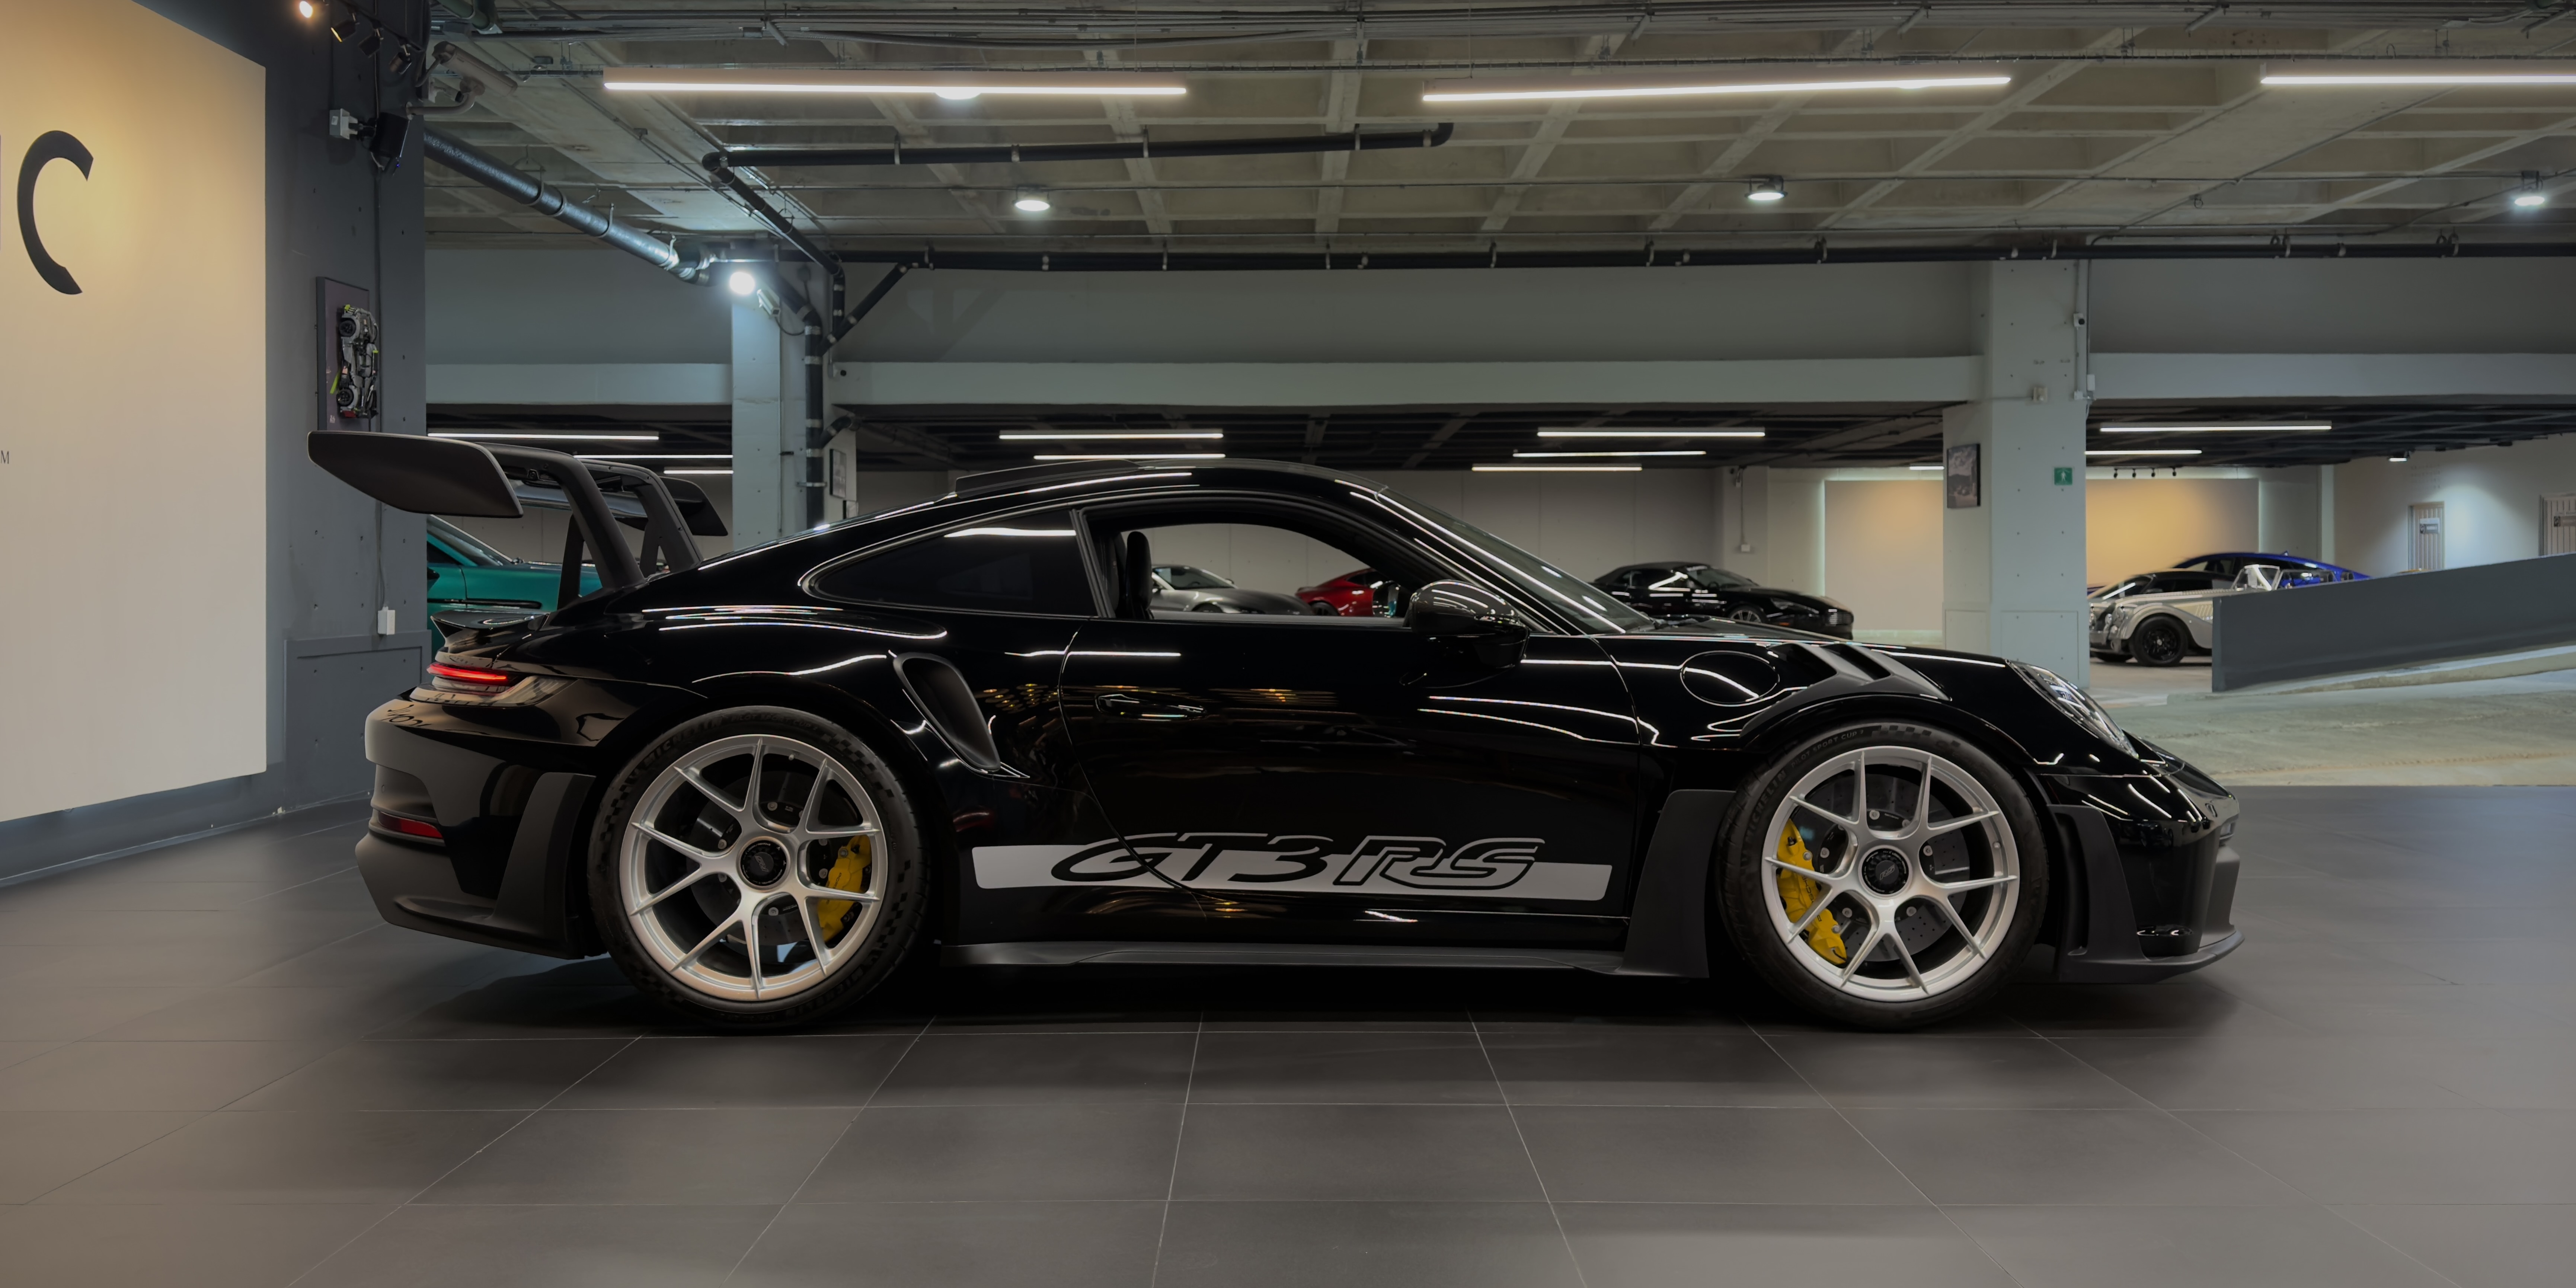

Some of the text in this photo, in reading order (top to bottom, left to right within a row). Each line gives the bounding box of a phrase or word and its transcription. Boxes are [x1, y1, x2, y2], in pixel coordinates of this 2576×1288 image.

[0, 130, 94, 295] C
[1813, 736, 1838, 752] SPORT
[1841, 730, 1857, 740] CUP
[1051, 832, 1546, 890] GT3 RS
